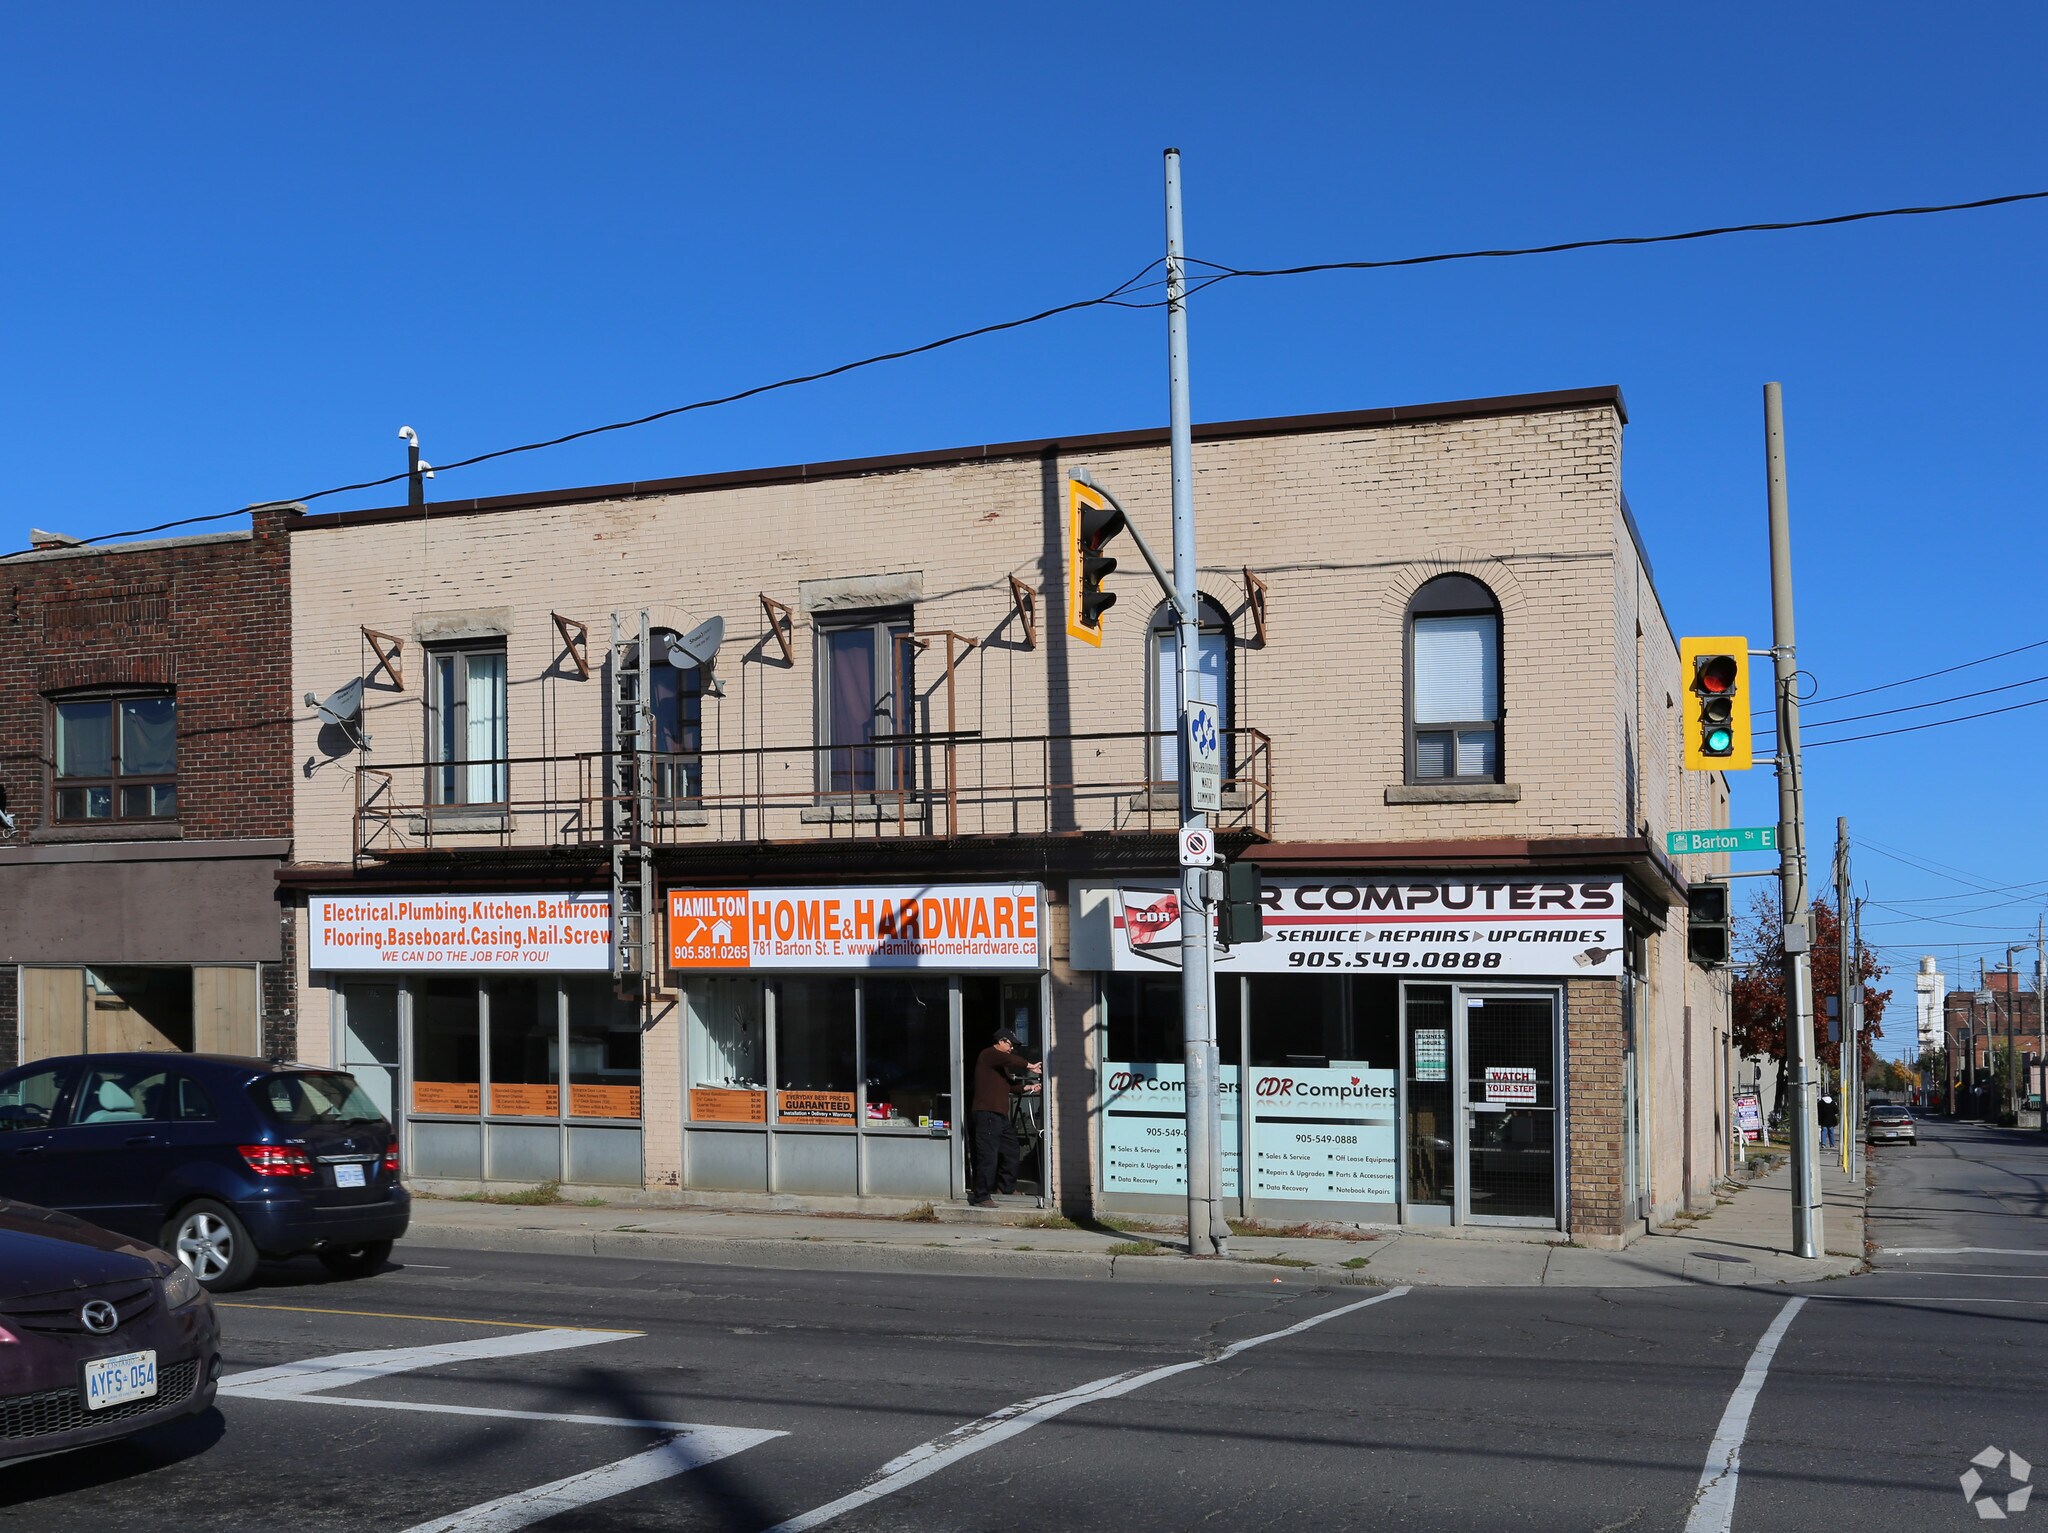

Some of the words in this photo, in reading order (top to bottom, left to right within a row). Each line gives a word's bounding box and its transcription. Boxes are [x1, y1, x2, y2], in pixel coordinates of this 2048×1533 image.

[1692, 834, 1738, 850] Barton
[1744, 831, 1754, 839] St
[1761, 830, 1771, 846] E
[1294, 882, 1614, 910] COMPUTERS
[674, 896, 746, 917] HAMILTON
[1136, 912, 1170, 922] CDR
[1276, 930, 1362, 942] SERVICE
[1378, 930, 1470, 942] REPAIRS
[1488, 930, 1607, 942] UPGRADES
[675, 946, 748, 960] 905.581.0265
[753, 941, 771, 956] 781
[776, 941, 812, 956] Barton
[816, 941, 830, 955] St.
[834, 941, 844, 955] E.
[848, 940, 1036, 956] www.HamiltonHomeHardware.ca
[382, 951, 398, 961] WE
[402, 951, 424, 961] CAN
[427, 951, 443, 961] DO
[447, 951, 467, 961] THE
[470, 951, 492, 961] JOB
[496, 951, 519, 961] FOR
[522, 951, 549, 962] YOU!
[1288, 952, 1502, 968] 905.549.0888
[1492, 1072, 1529, 1080] WATCH
[1109, 1072, 1144, 1091] CDR
[1146, 1077, 1242, 1093] Comers
[1256, 1077, 1293, 1097] CDR
[1296, 1082, 1397, 1100] Computers
[786, 1101, 850, 1110] GUARANTEED
[1296, 1134, 1358, 1144] 905-549-0888
[1147, 1162, 1174, 1170] Upgrades
[1266, 1169, 1288, 1177] Repairs
[1133, 1176, 1158, 1184] Recovery
[1282, 1184, 1308, 1193] Recovery
[1368, 1187, 1390, 1195] Repairs
[92, 1370, 122, 1397] AYFS
[130, 1362, 154, 1389] 054
